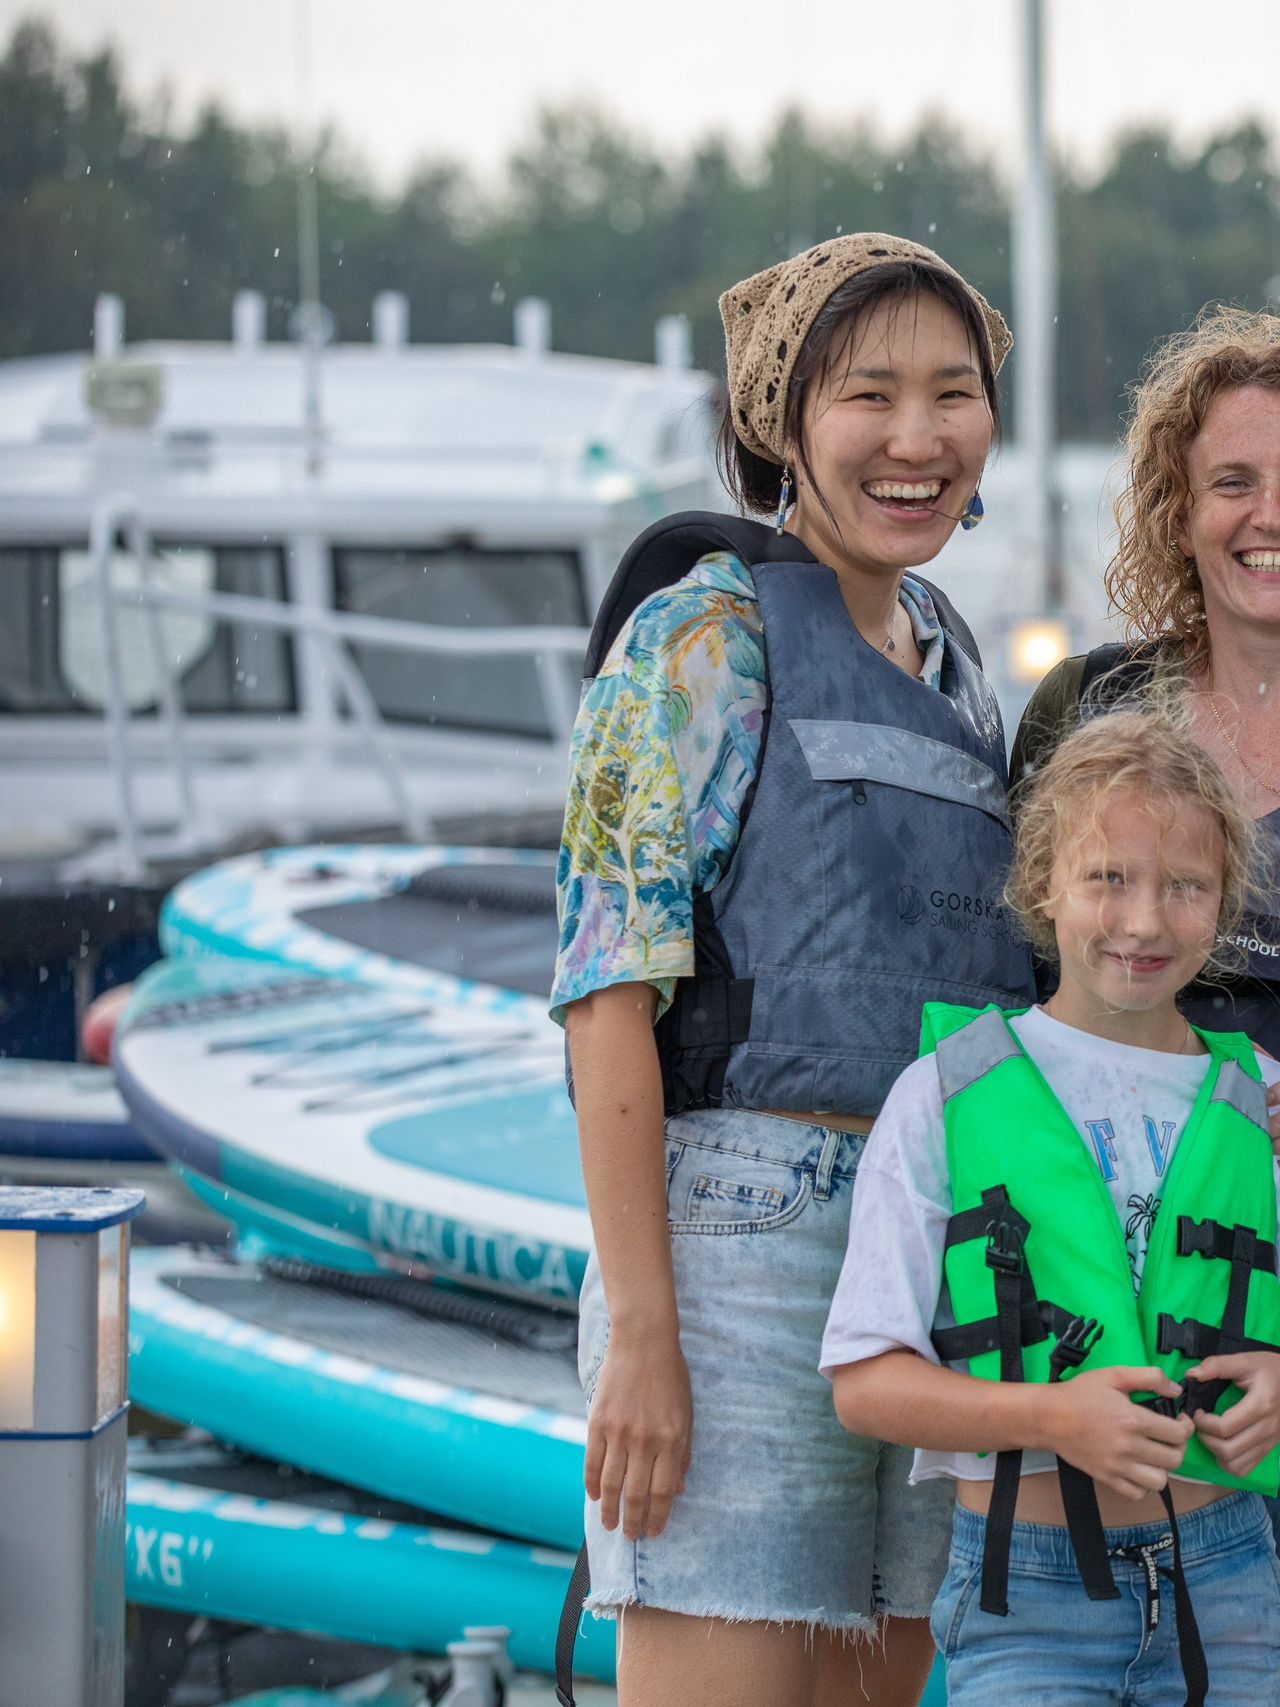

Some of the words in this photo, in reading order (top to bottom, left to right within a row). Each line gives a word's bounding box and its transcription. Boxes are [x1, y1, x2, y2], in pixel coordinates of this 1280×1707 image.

[930, 890, 1014, 925] GORSKA
[930, 912, 978, 934] SAILING
[368, 1198, 578, 1298] NAUTICA
[1151, 1599, 1159, 1625] WAVE
